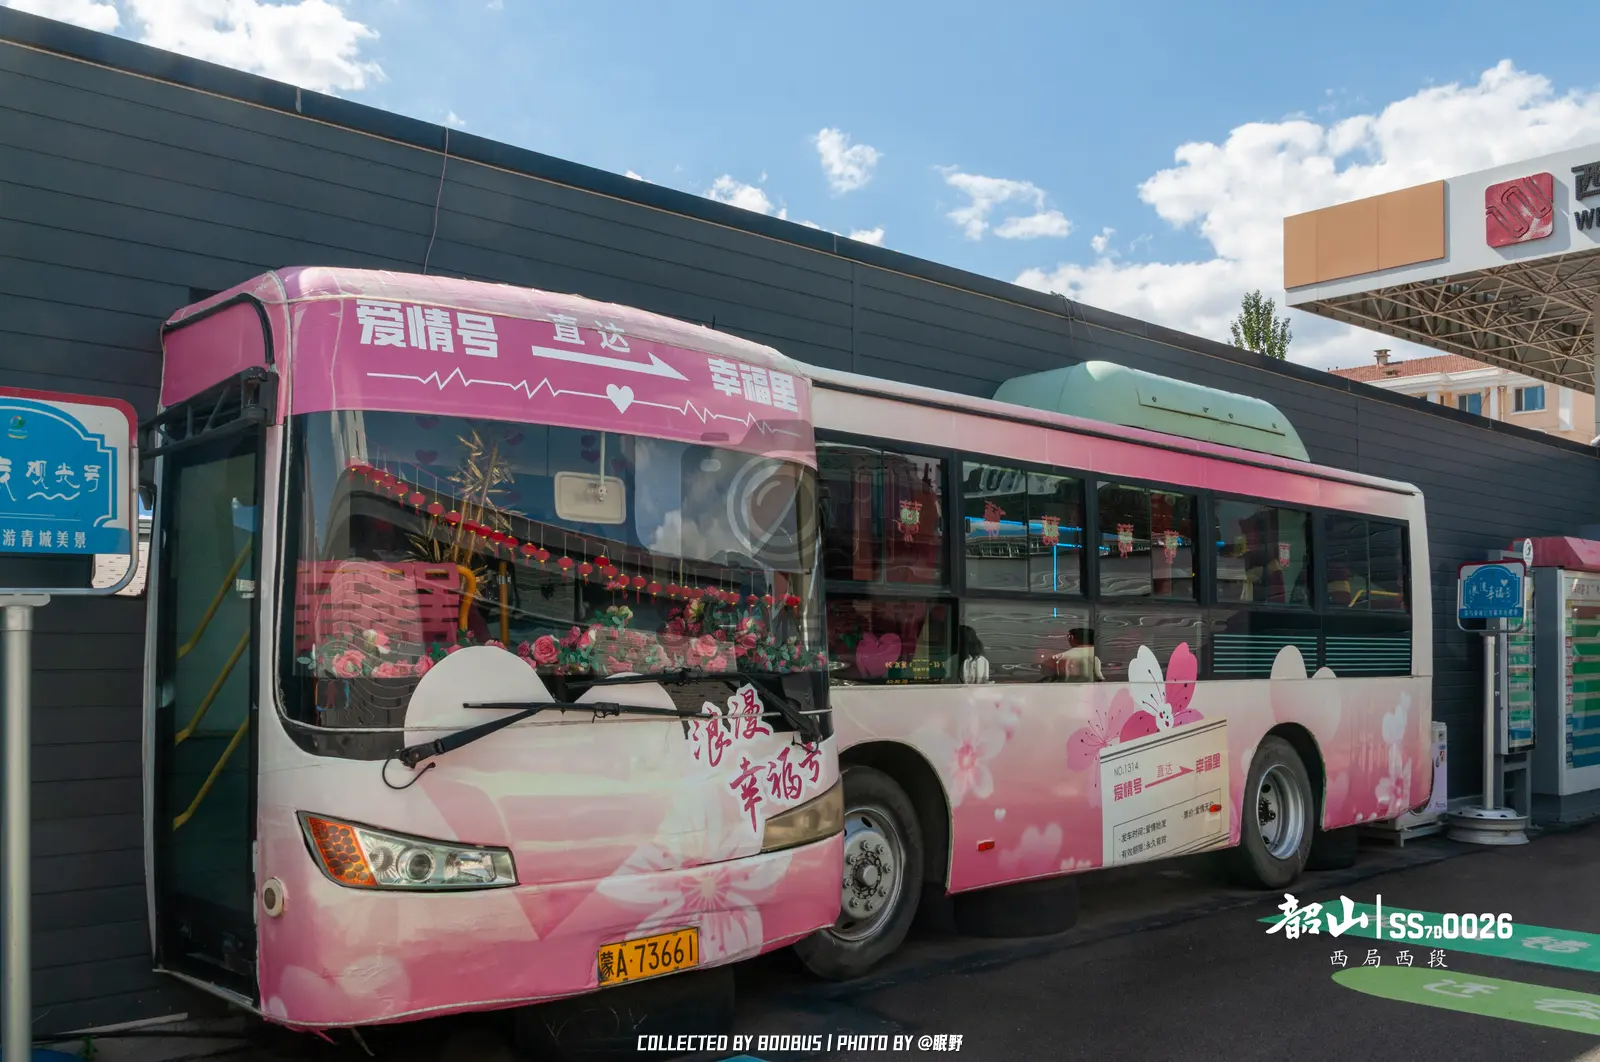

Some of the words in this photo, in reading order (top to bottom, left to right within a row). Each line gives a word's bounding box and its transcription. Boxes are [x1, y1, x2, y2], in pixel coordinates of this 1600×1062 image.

[356, 299, 498, 358] 爱情号
[546, 312, 631, 354] 直达
[707, 358, 798, 413] 幸福里
[2, 528, 87, 549] 游青城美景
[1113, 761, 1139, 776] NO.1314
[1156, 762, 1173, 778] 直达
[1195, 752, 1221, 774] 幸福里
[1113, 777, 1142, 802] 爱情号
